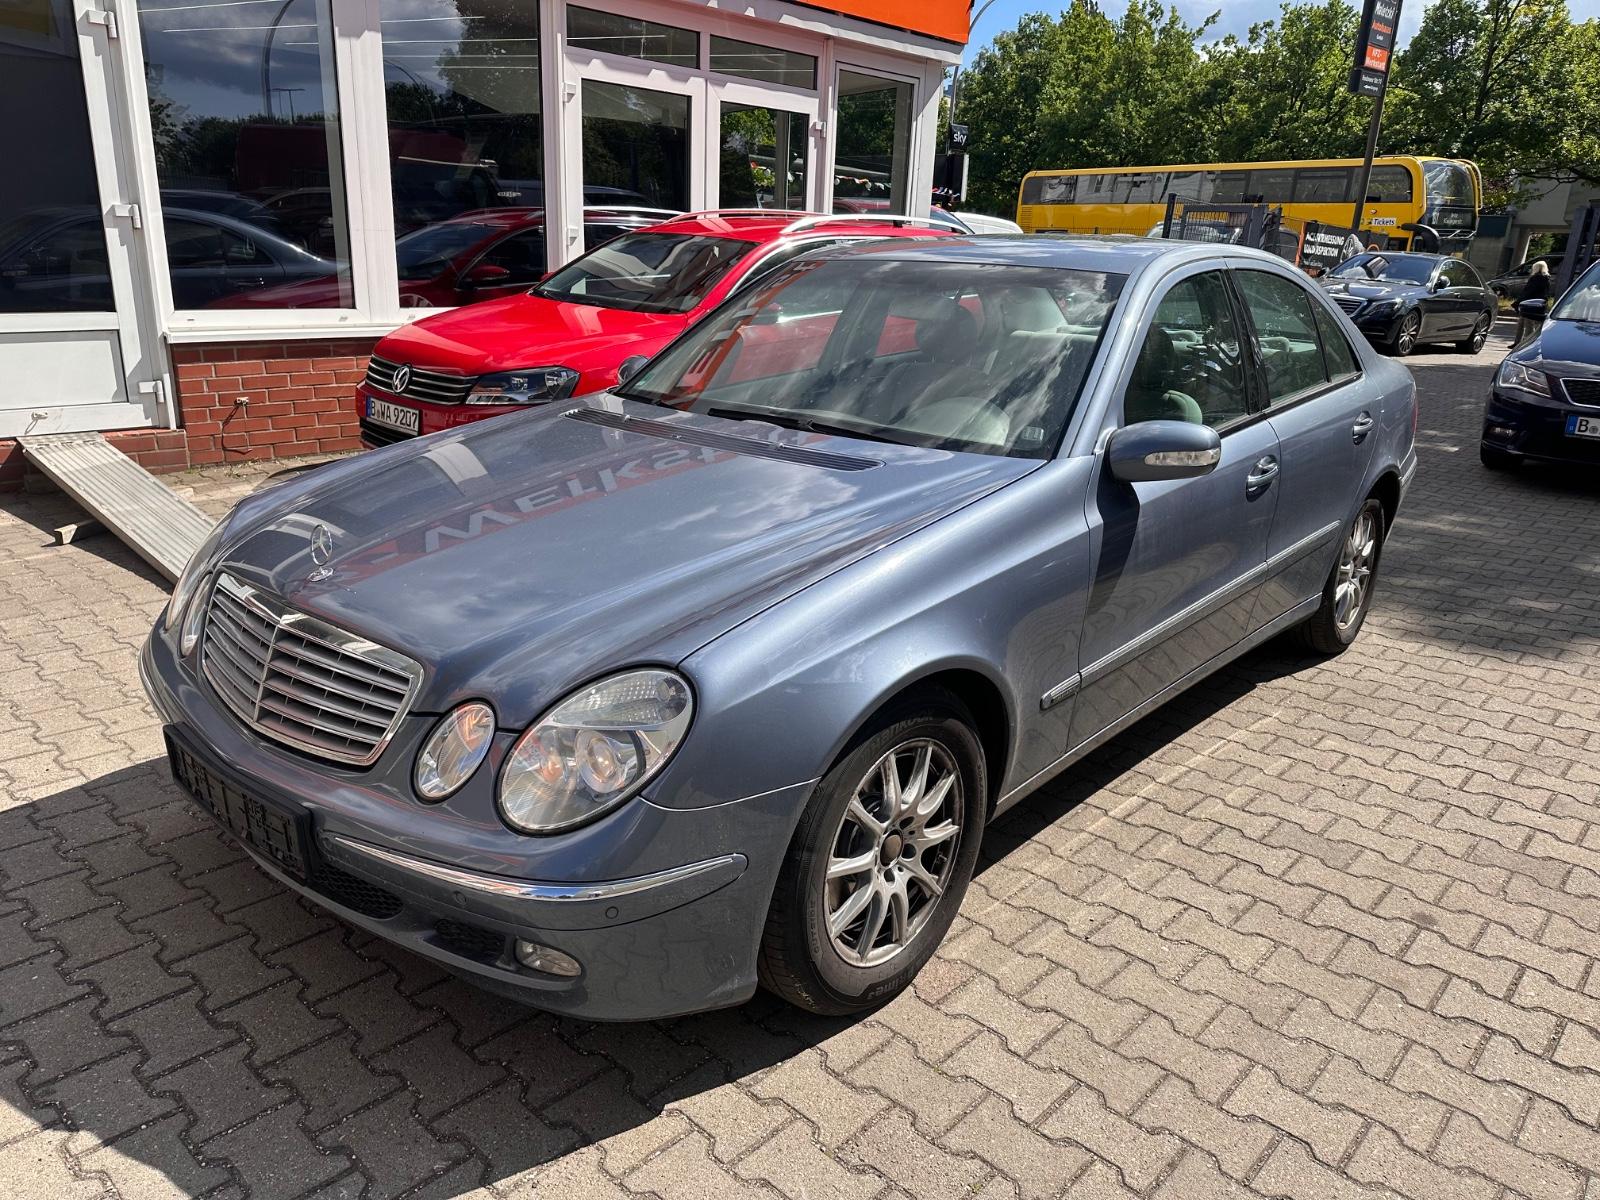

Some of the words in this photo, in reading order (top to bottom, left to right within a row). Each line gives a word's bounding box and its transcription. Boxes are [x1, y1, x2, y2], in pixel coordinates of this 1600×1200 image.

[953, 131, 967, 146] sky
[1373, 218, 1395, 226] Tickets
[380, 402, 392, 421] WA
[393, 407, 418, 429] 9207
[1577, 418, 1590, 433] B
